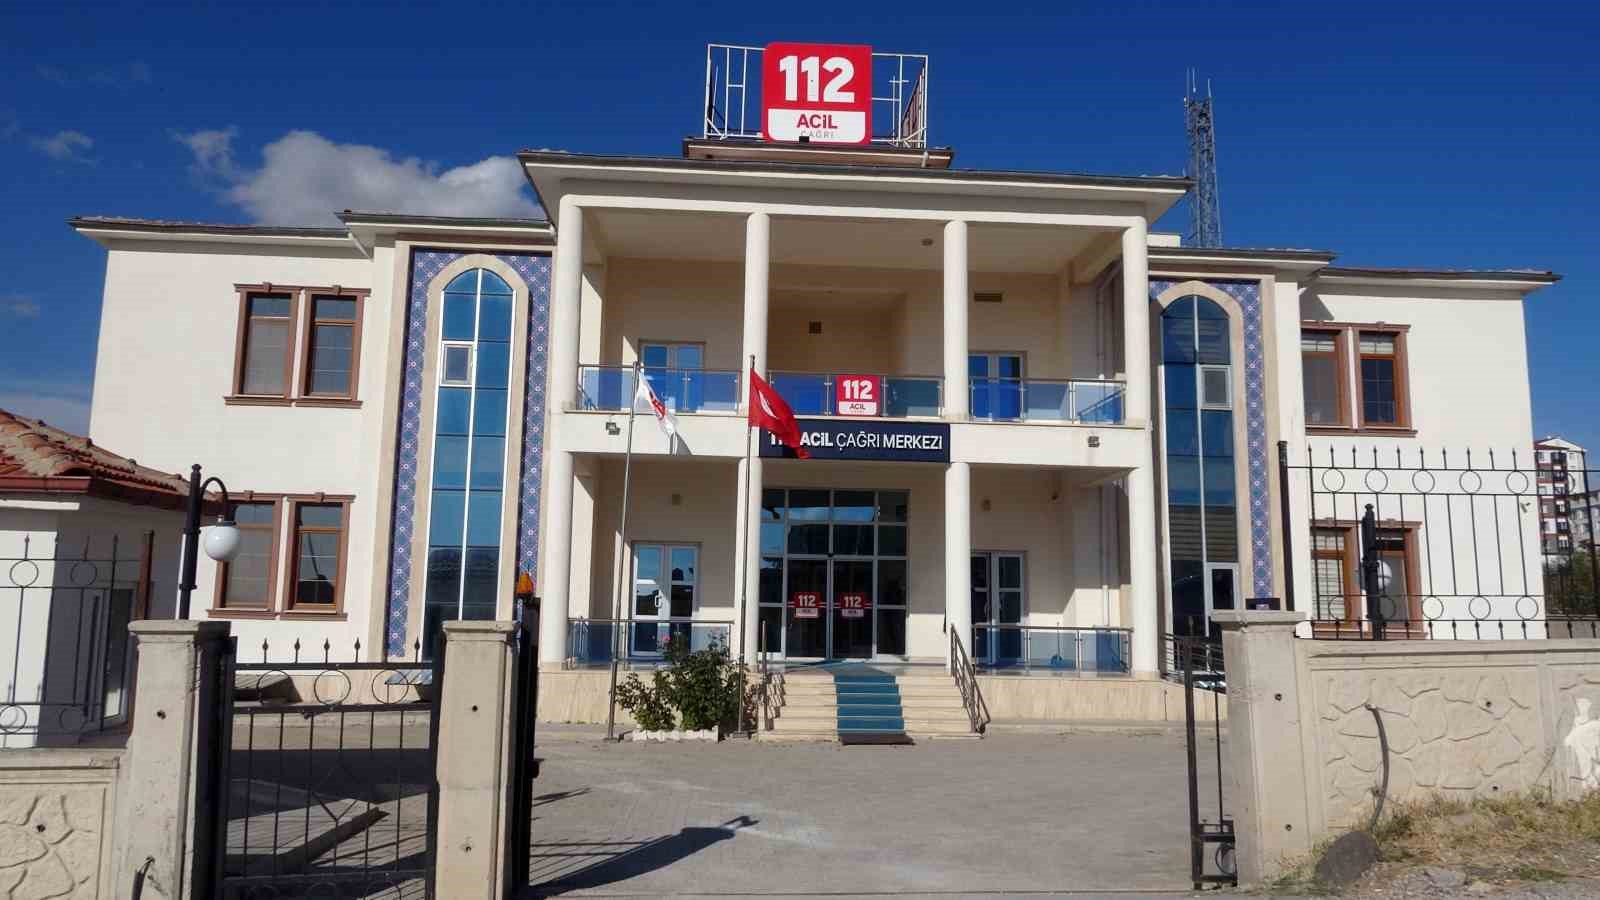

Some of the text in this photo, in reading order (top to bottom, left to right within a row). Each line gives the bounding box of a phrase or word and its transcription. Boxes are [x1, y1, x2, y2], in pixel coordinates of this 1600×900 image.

[779, 55, 855, 103] 112
[843, 379, 873, 400] 112
[836, 430, 880, 451] ÇAĞRI
[798, 594, 816, 607] 112
[843, 596, 862, 608] 112
